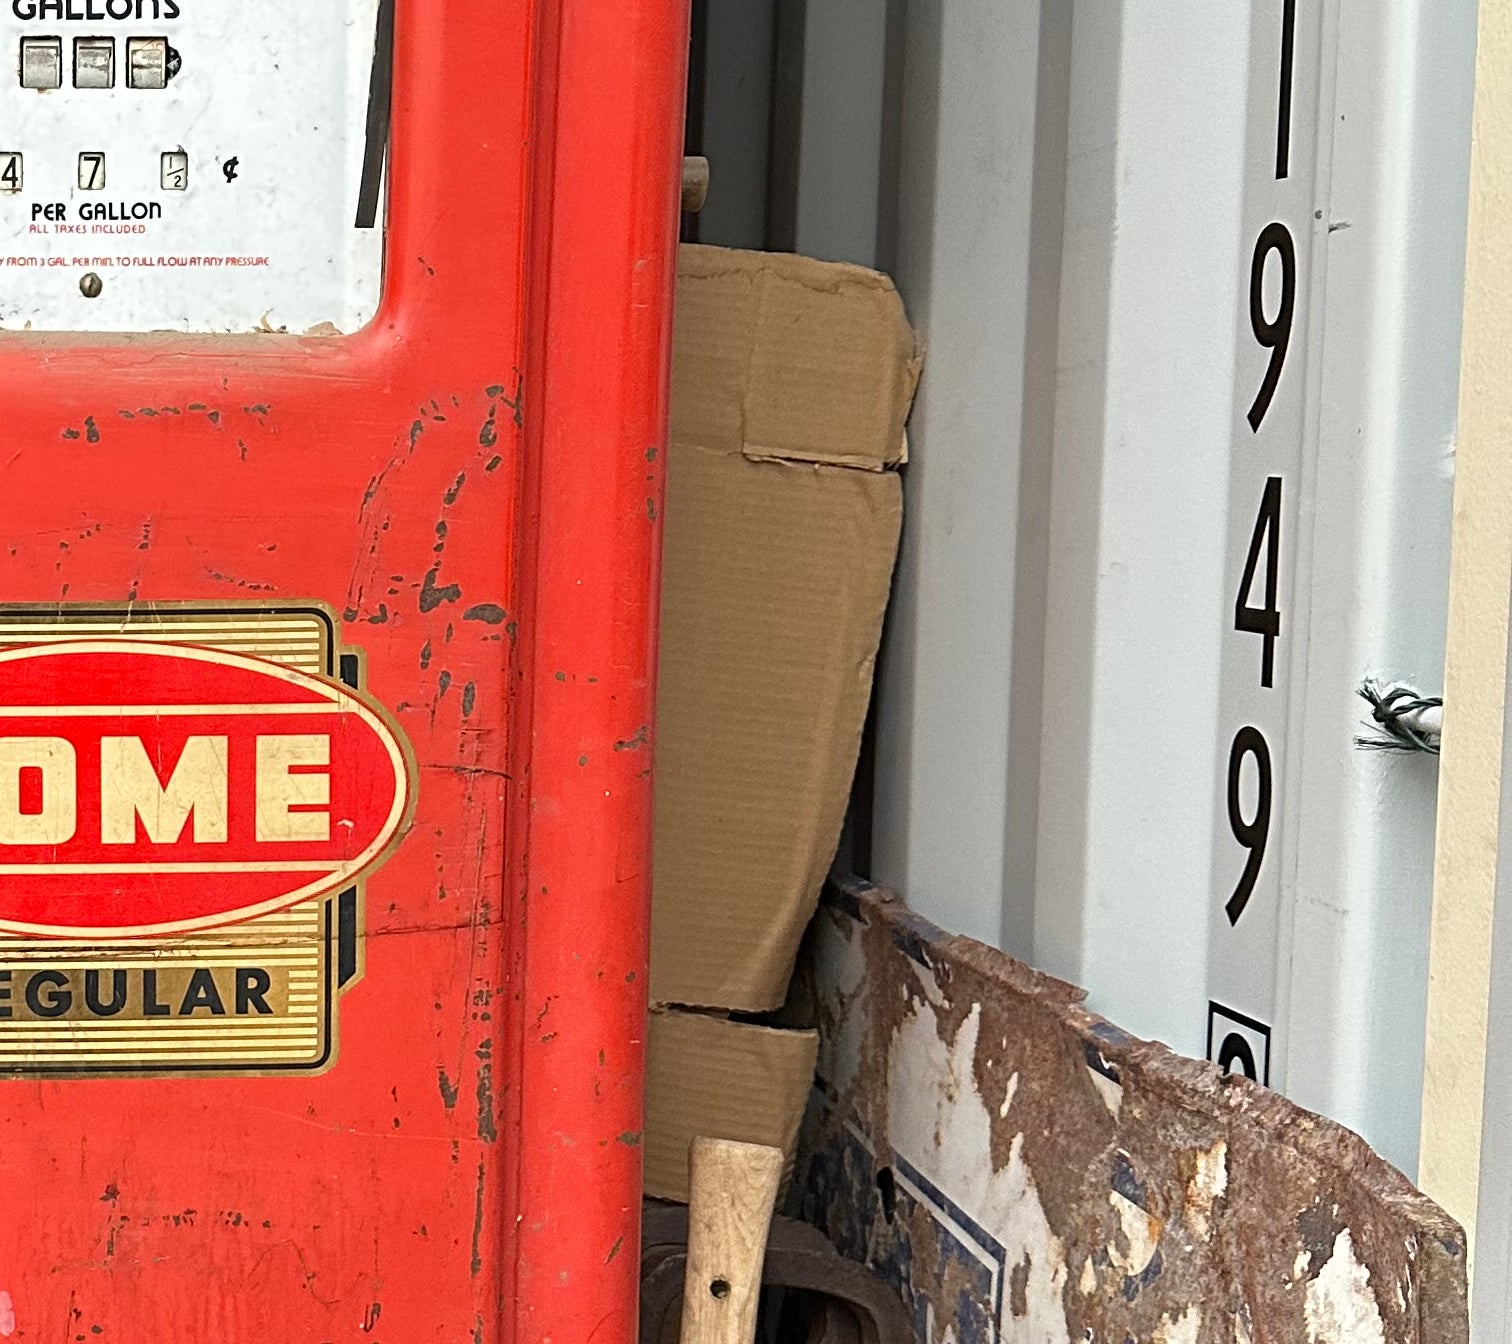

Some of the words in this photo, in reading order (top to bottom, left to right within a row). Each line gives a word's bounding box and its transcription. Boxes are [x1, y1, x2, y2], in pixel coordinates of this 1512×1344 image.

[1, 156, 19, 188] 4
[83, 157, 101, 189] 7
[31, 203, 66, 221] PER
[79, 202, 162, 221] GALLON
[29, 224, 49, 234] ALL
[55, 224, 87, 234] TAXES
[91, 224, 146, 234] INCLUDED
[6, 256, 38, 267] FROM
[72, 256, 90, 267] PER
[116, 256, 131, 267] TO
[133, 256, 155, 267] FULL
[157, 256, 188, 267] FLOW
[189, 256, 201, 267] AT
[203, 256, 224, 267] ANY
[225, 256, 270, 267] PRESSURE
